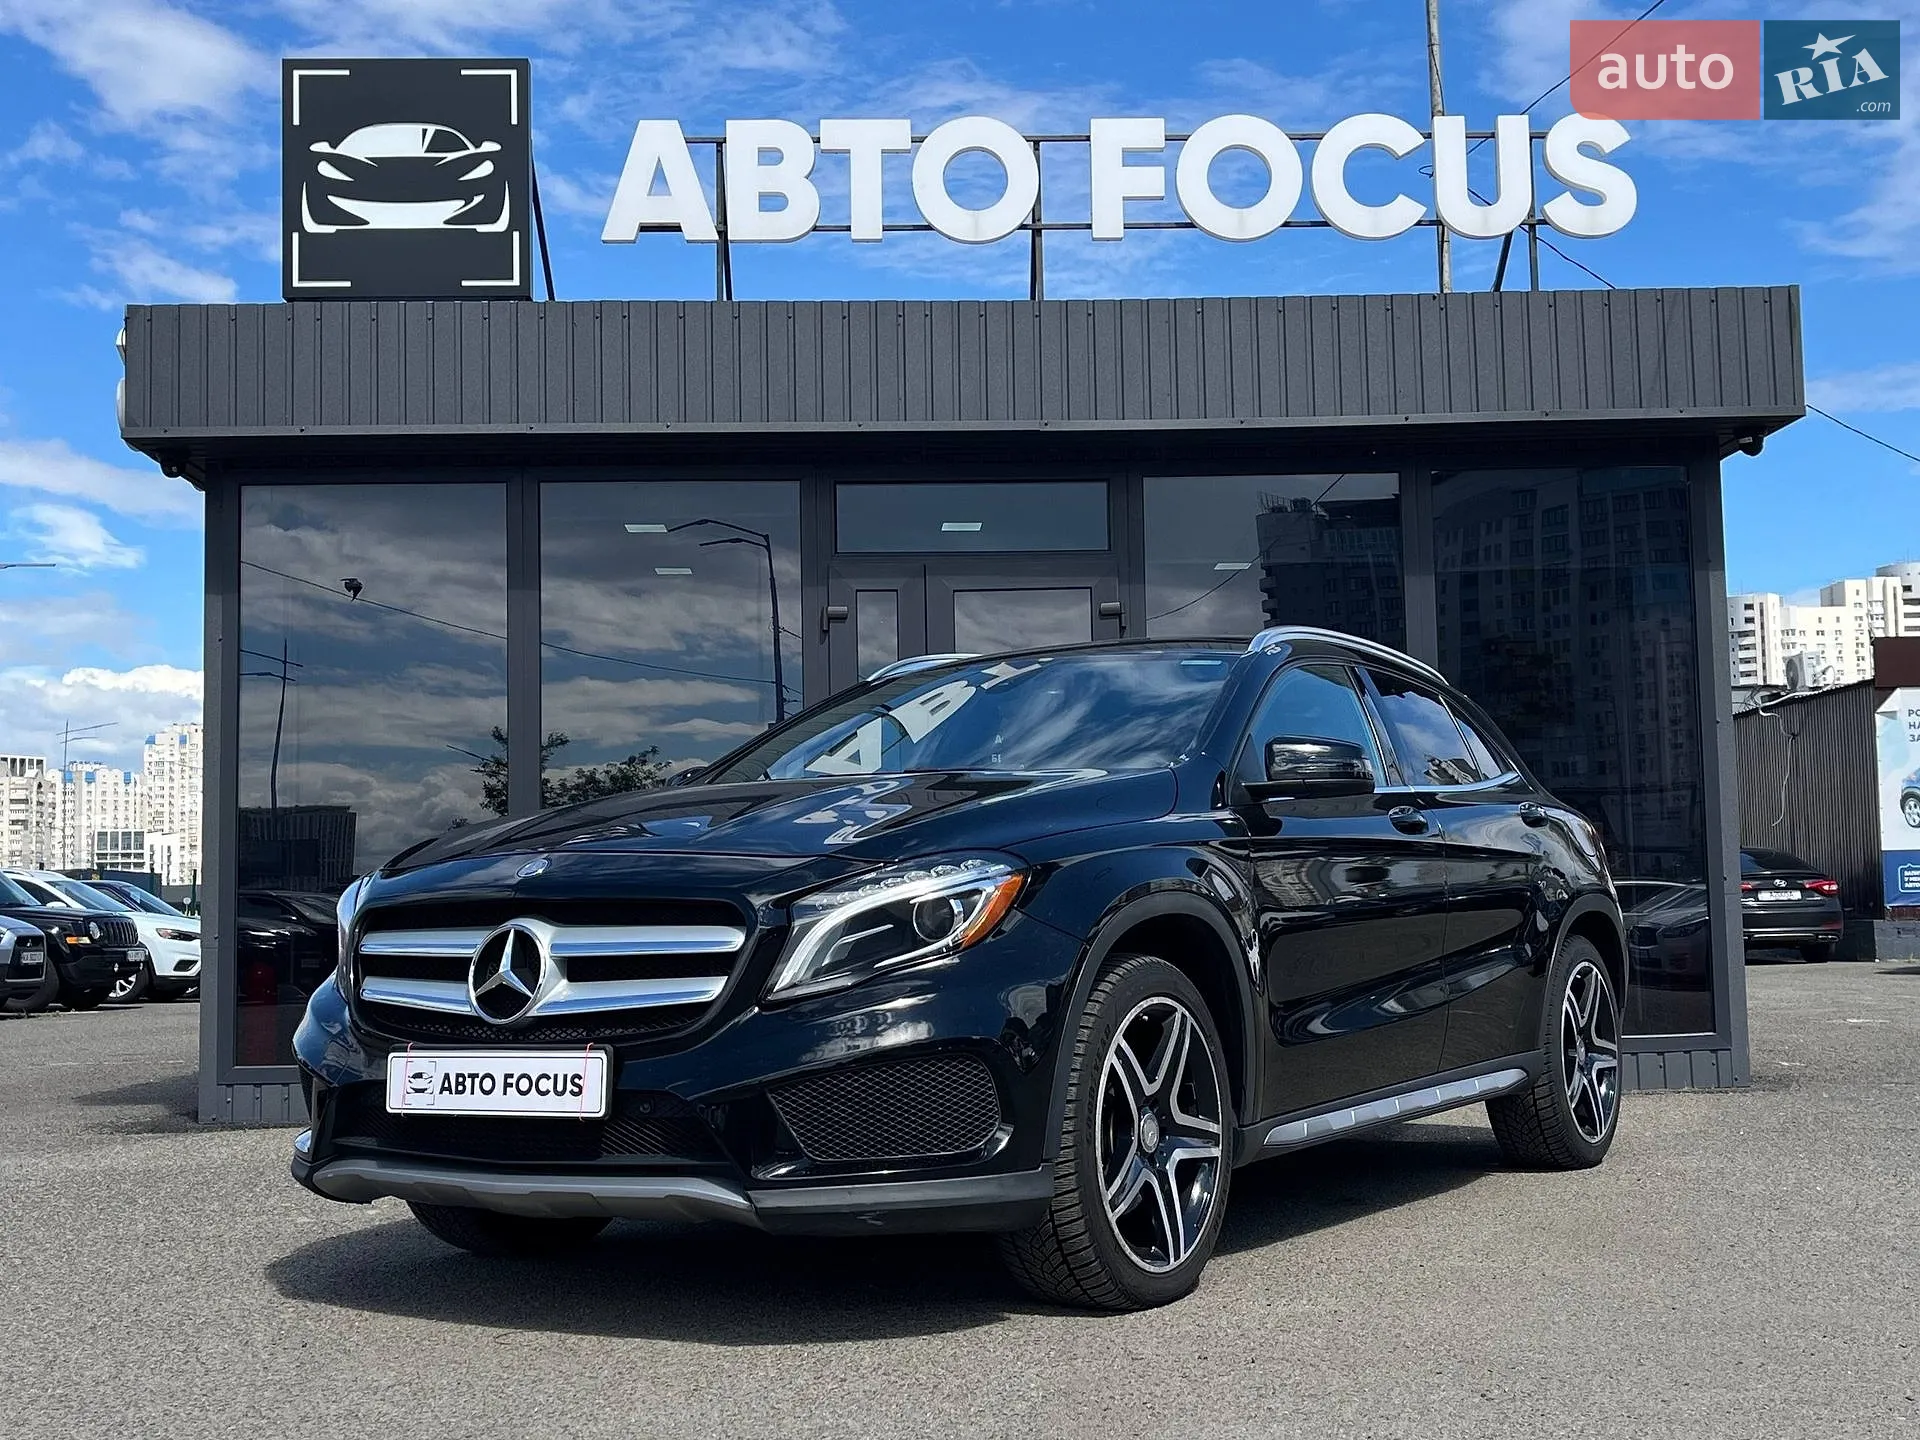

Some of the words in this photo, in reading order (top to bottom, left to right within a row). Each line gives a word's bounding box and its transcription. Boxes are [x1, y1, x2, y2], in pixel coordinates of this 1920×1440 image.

[602, 117, 1039, 241] АВТО
[1091, 113, 1637, 239] FOCUS
[438, 1072, 496, 1096] АВТО
[502, 1073, 584, 1097] FOCUS
